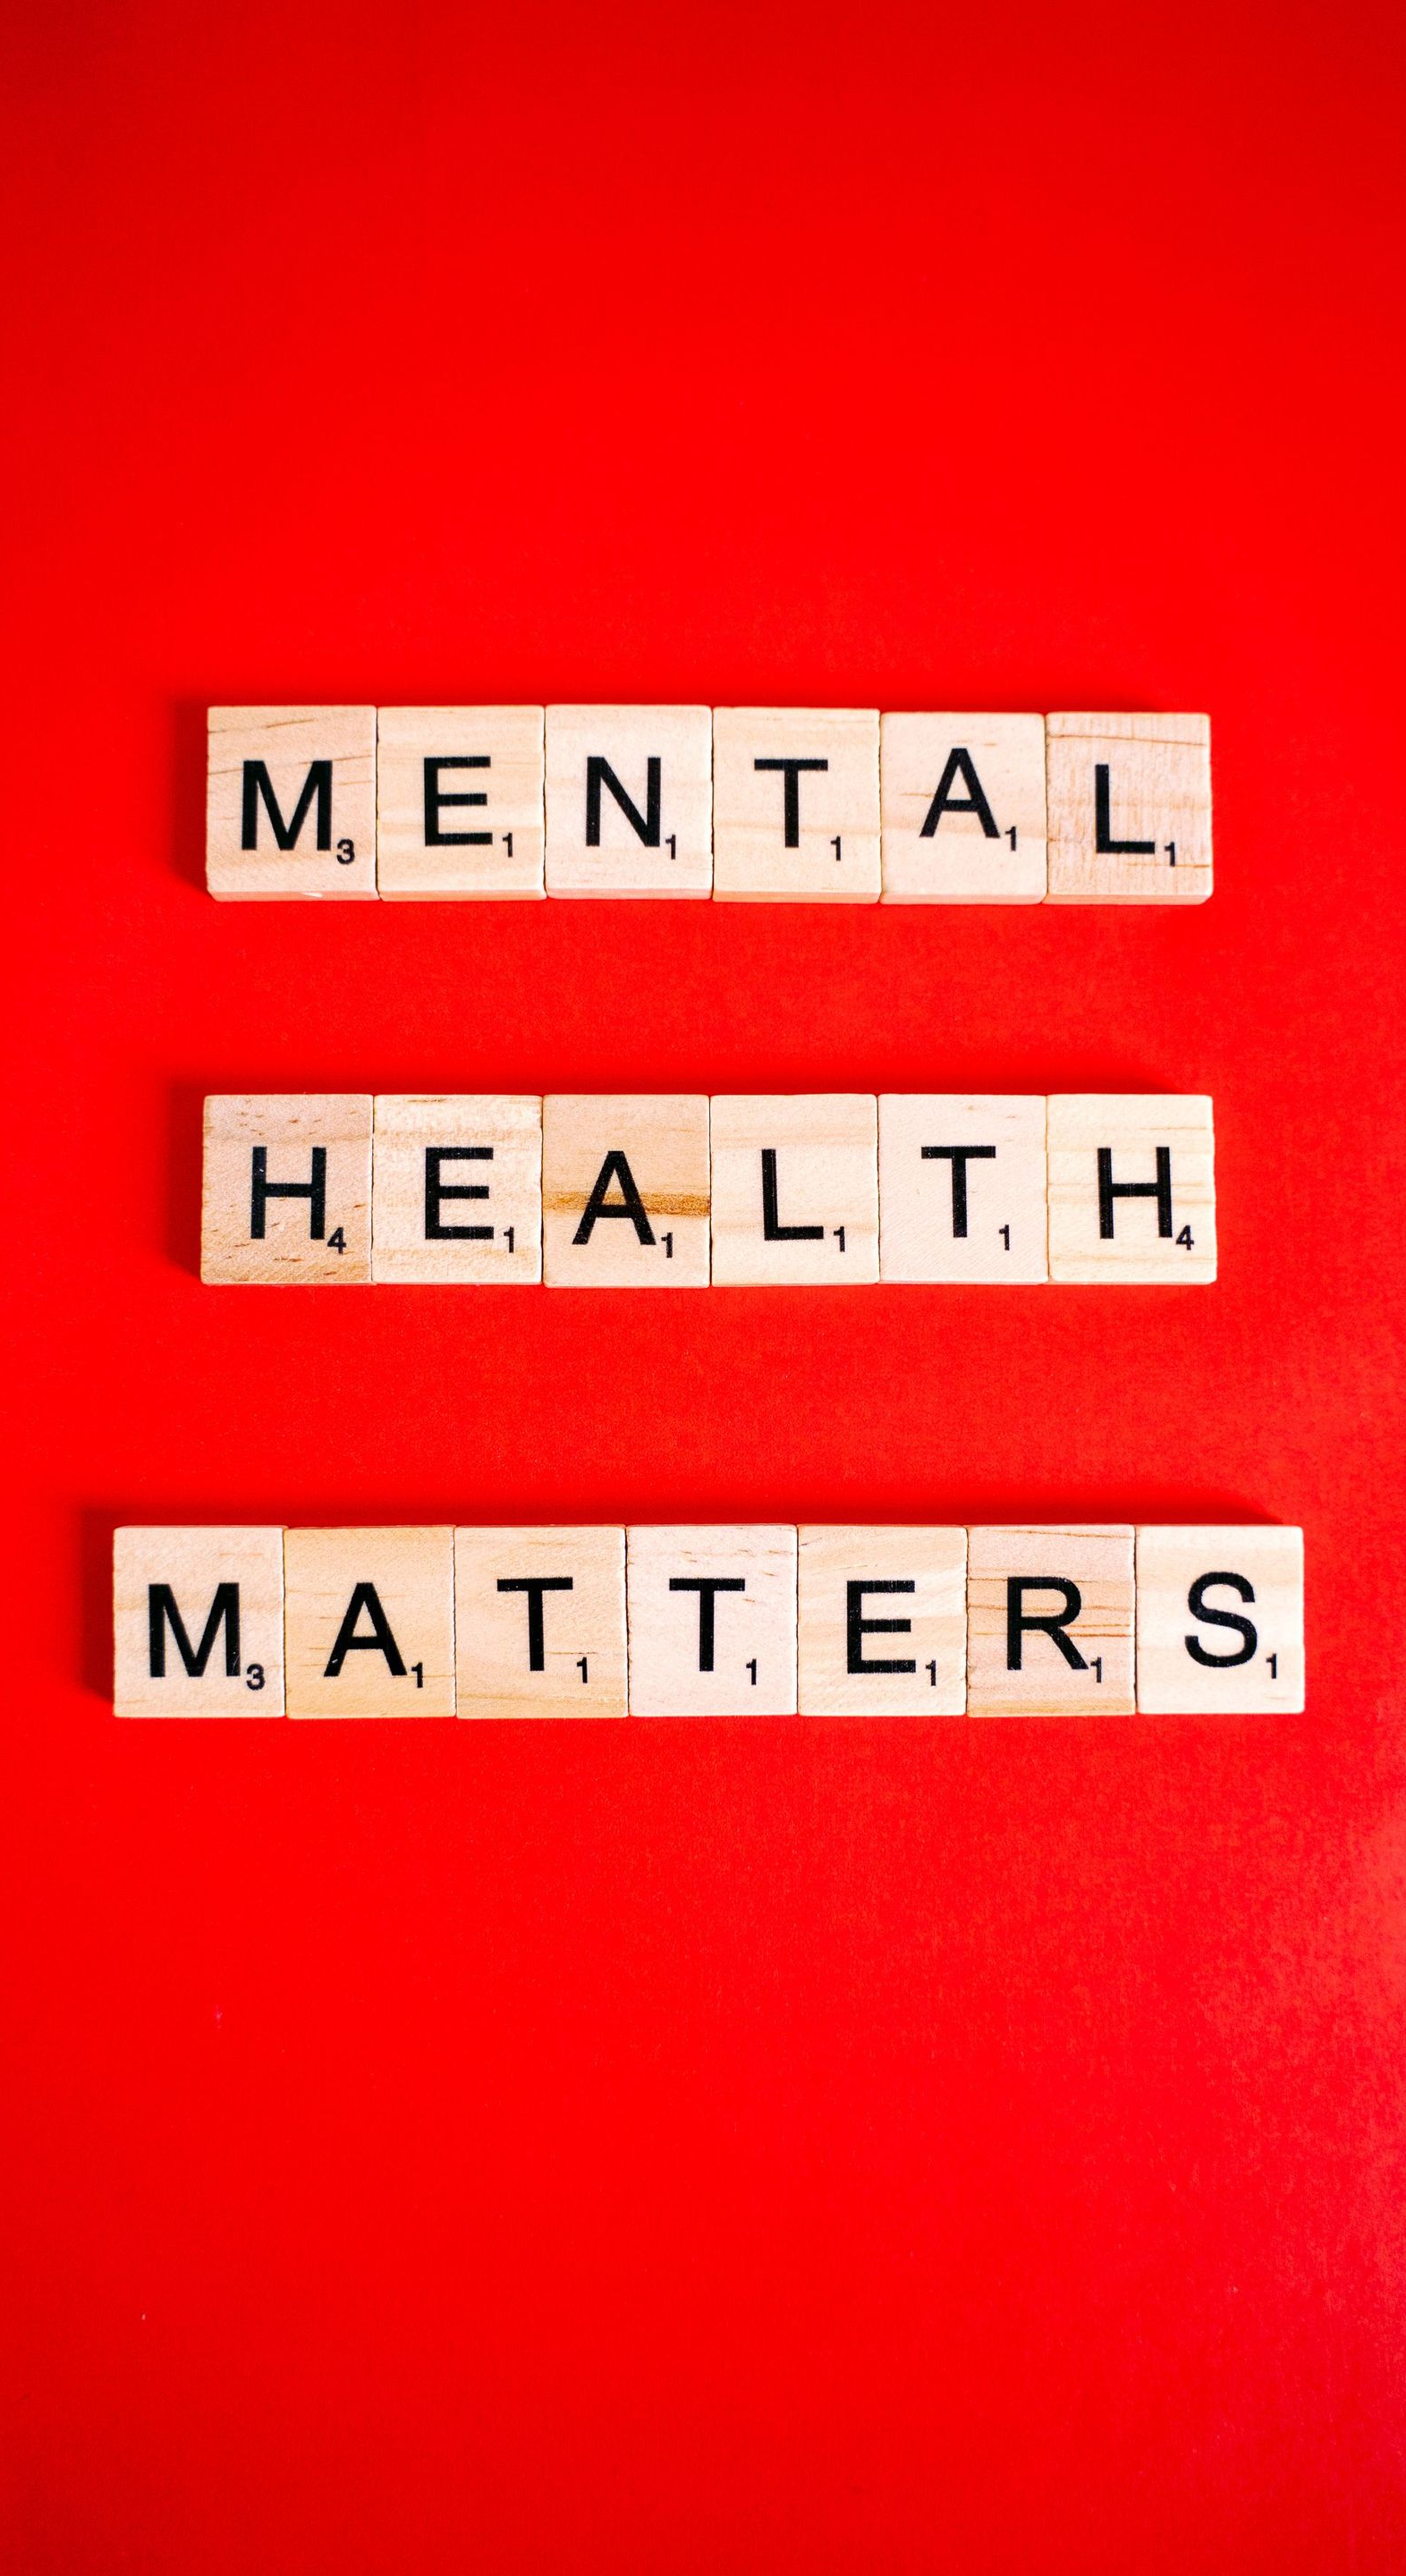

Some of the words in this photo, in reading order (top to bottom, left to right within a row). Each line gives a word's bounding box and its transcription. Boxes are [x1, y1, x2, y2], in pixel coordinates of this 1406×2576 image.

[241, 748, 1156, 854] MENTAL
[336, 838, 355, 865] 3
[502, 832, 513, 858] 1
[665, 835, 676, 860] 1
[830, 835, 842, 861] 1
[1005, 826, 1017, 852] 1
[1165, 842, 1176, 867] 1
[250, 1145, 1173, 1246] HEALTH
[326, 1226, 347, 1254] 4
[504, 1226, 514, 1253] 1
[661, 1232, 673, 1258] 1
[833, 1225, 845, 1253] 1
[998, 1224, 1010, 1251] 1
[1175, 1224, 1195, 1250] 4
[148, 1572, 1258, 1678] MATTERS
[246, 1663, 266, 1690] 3
[411, 1662, 424, 1689] 1
[576, 1657, 588, 1684] 1
[746, 1658, 757, 1686] 1
[925, 1659, 936, 1687] 1
[1090, 1657, 1102, 1683] 1
[1266, 1653, 1277, 1679] 1
